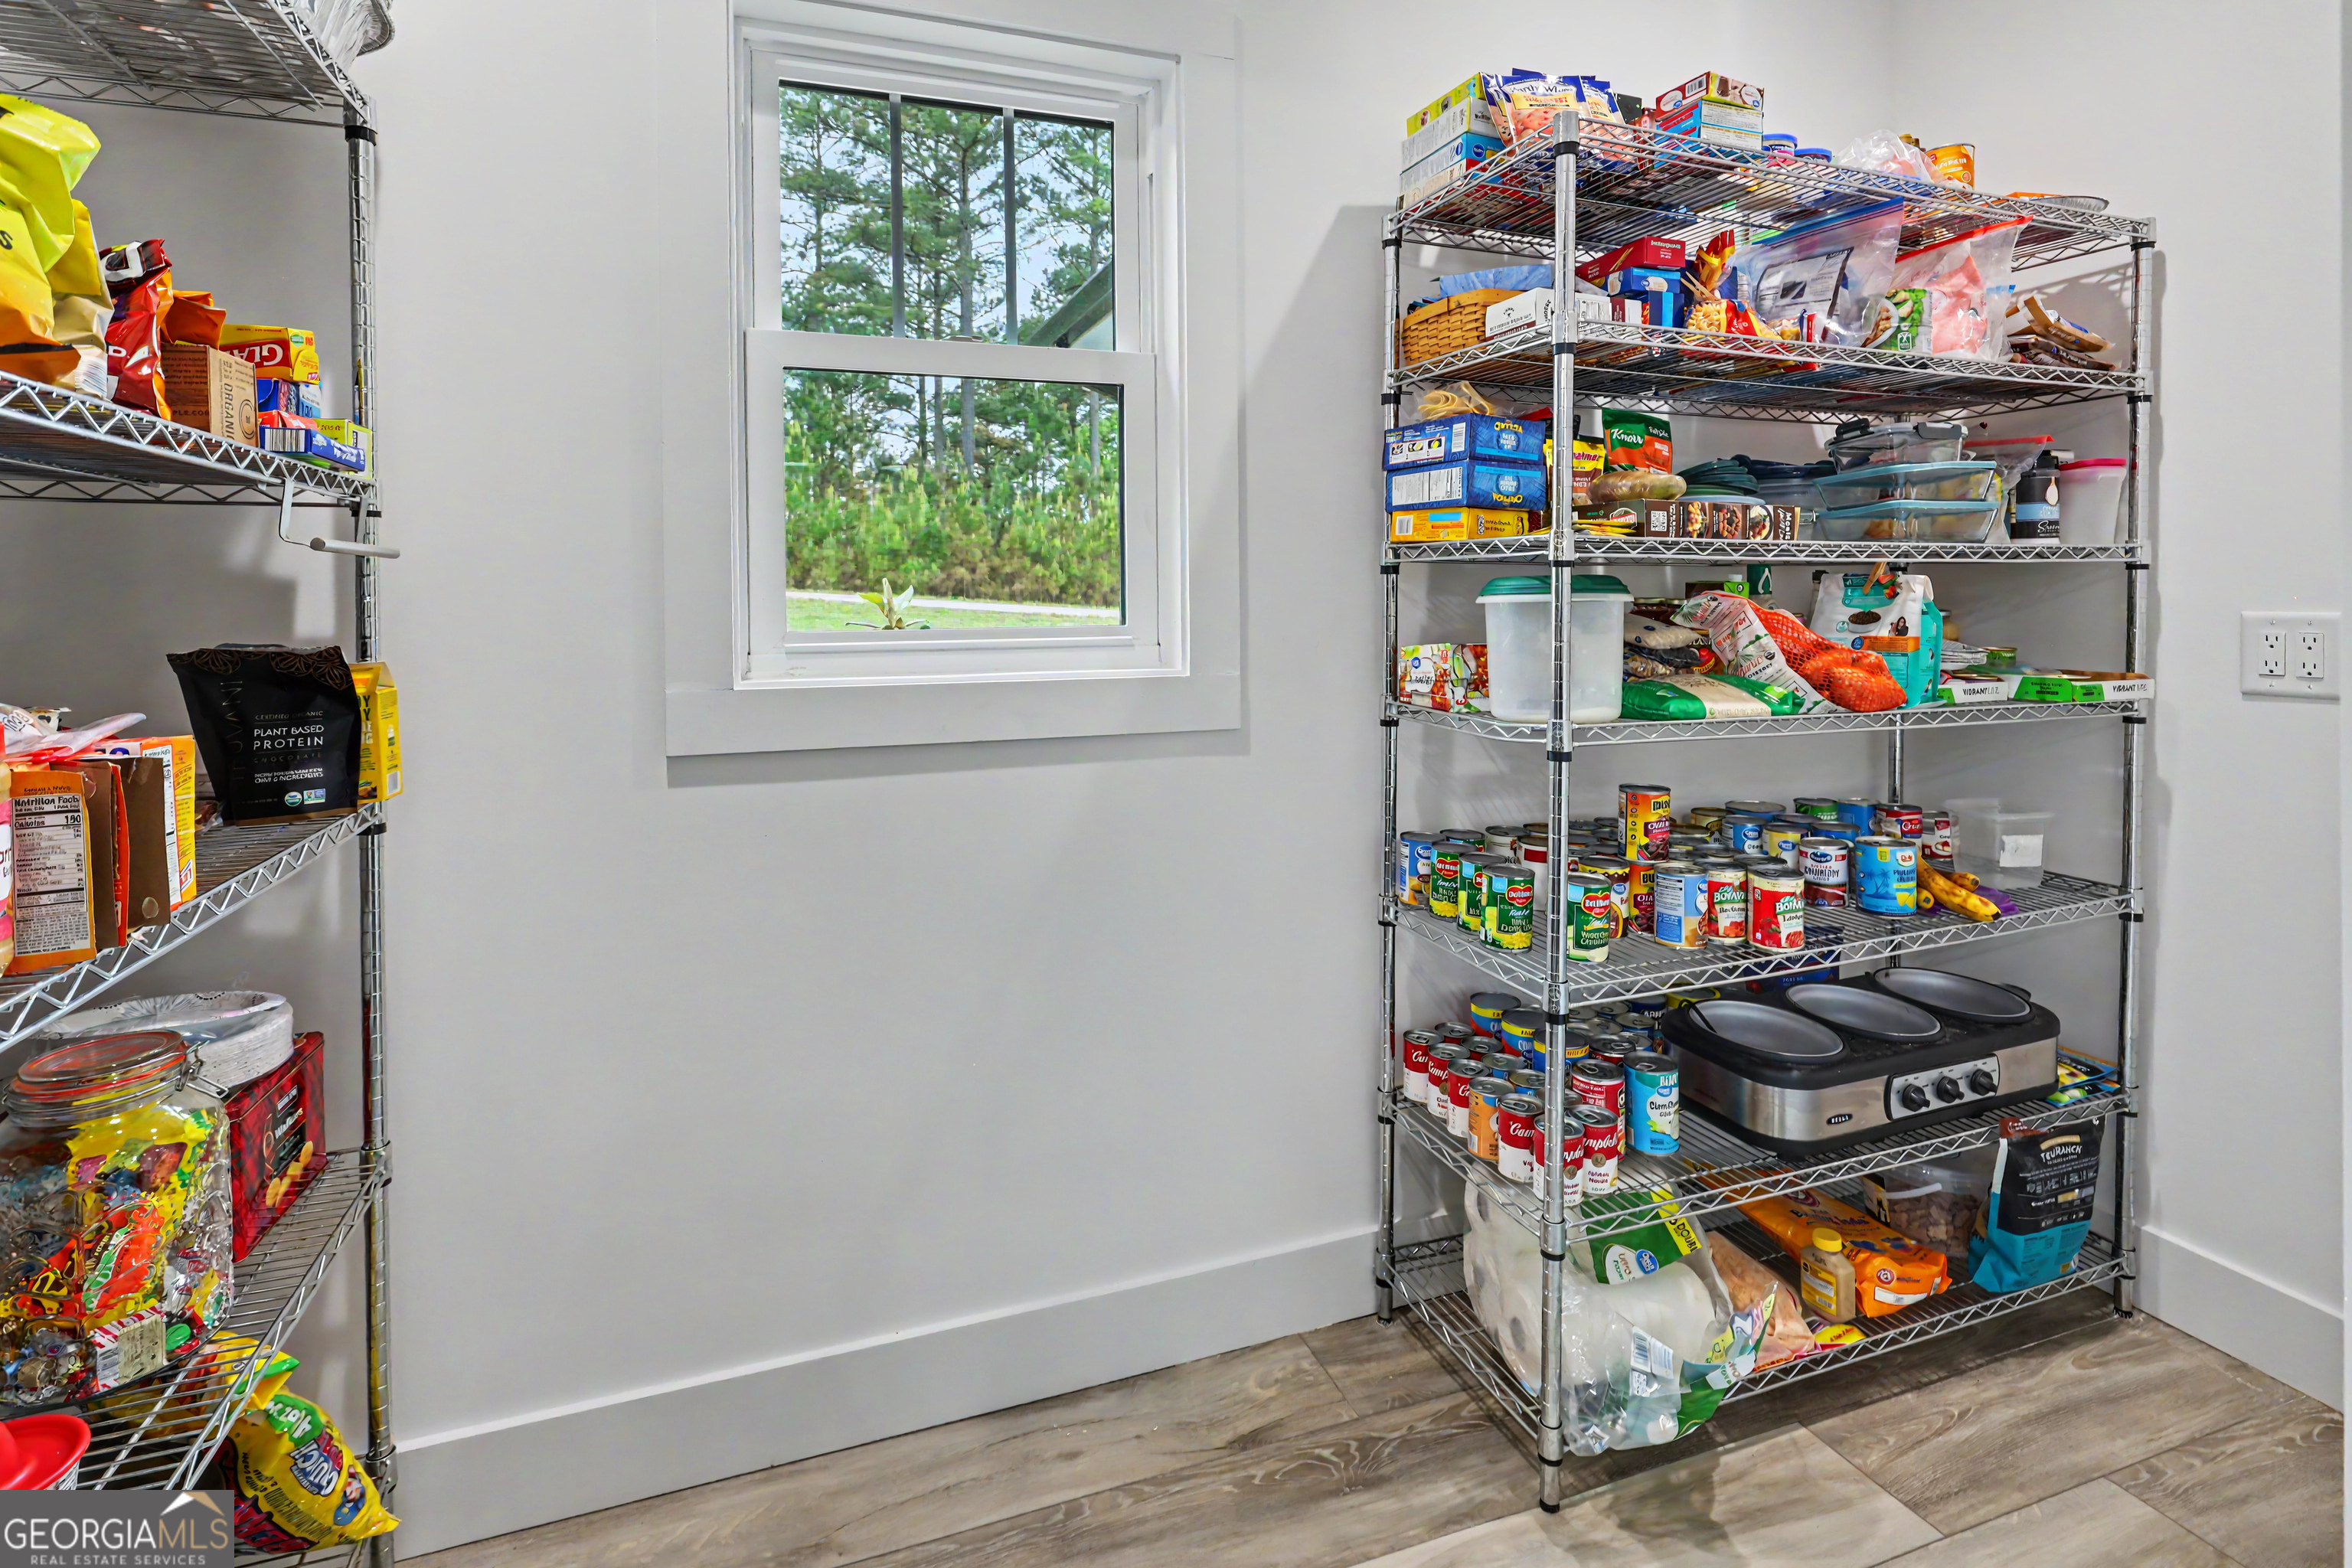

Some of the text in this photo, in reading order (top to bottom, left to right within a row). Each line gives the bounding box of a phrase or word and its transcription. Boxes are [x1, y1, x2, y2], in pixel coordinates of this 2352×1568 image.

[1610, 428, 1645, 444] Knorr
[253, 724, 325, 737] PLANT BASED
[253, 736, 324, 750] PROTEIN
